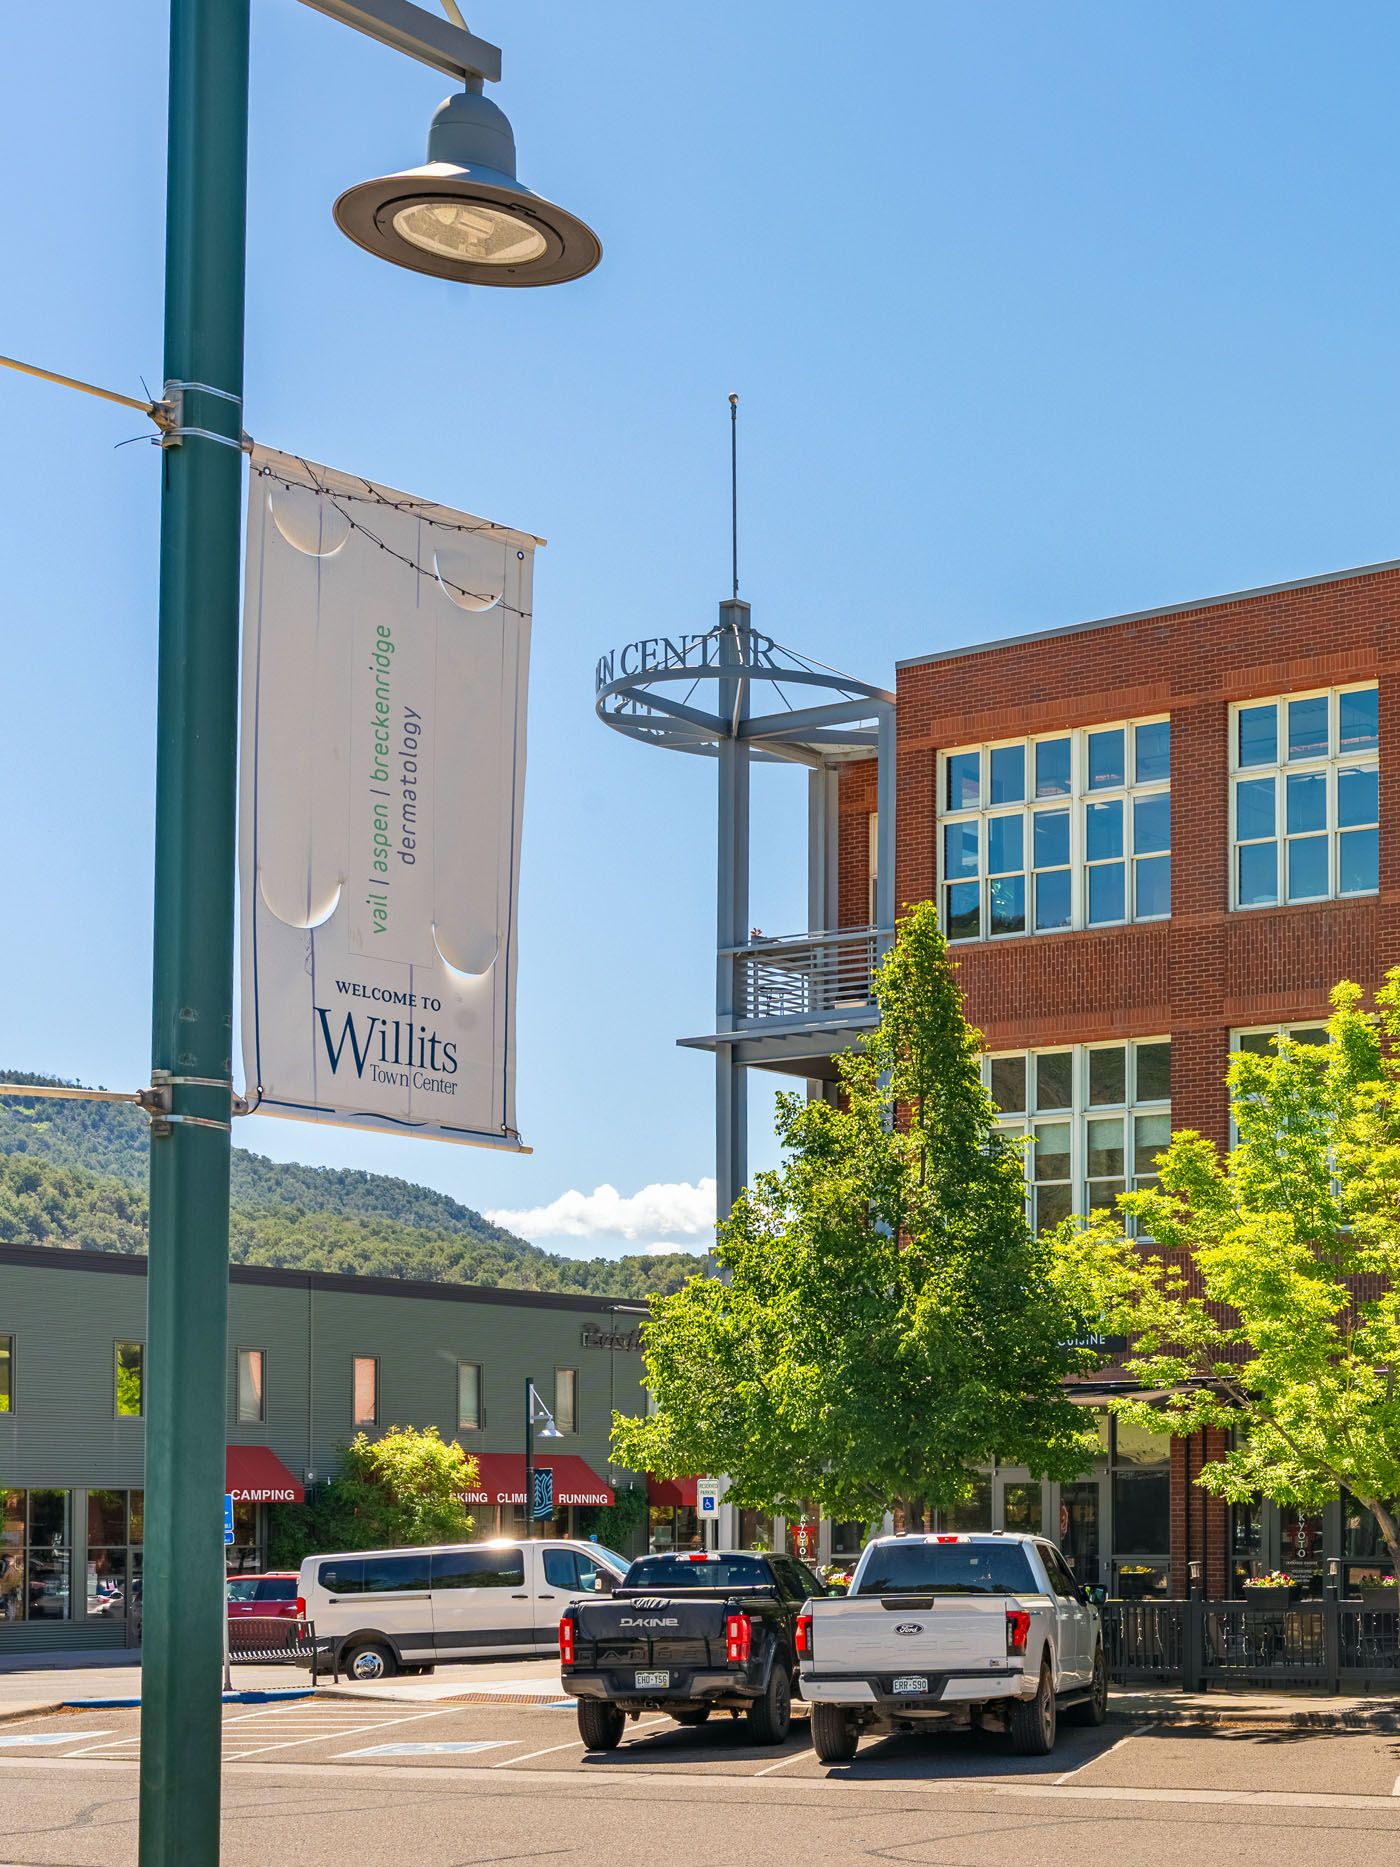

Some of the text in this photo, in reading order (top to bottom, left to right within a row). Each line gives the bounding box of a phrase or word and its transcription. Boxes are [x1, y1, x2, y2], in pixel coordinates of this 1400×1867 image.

[368, 625, 395, 782] breckenridge
[397, 705, 422, 866] dermatology
[373, 803, 393, 873] aspen
[366, 893, 388, 934] vail
[335, 979, 442, 1012] WELCOME TO
[313, 1007, 459, 1080] Willits
[369, 1063, 459, 1096] Town Center
[231, 1489, 295, 1500] CAMPING
[558, 1493, 609, 1505] RUNNING
[800, 1514, 808, 1554] KYOTO
[619, 1618, 680, 1627] DAKINE
